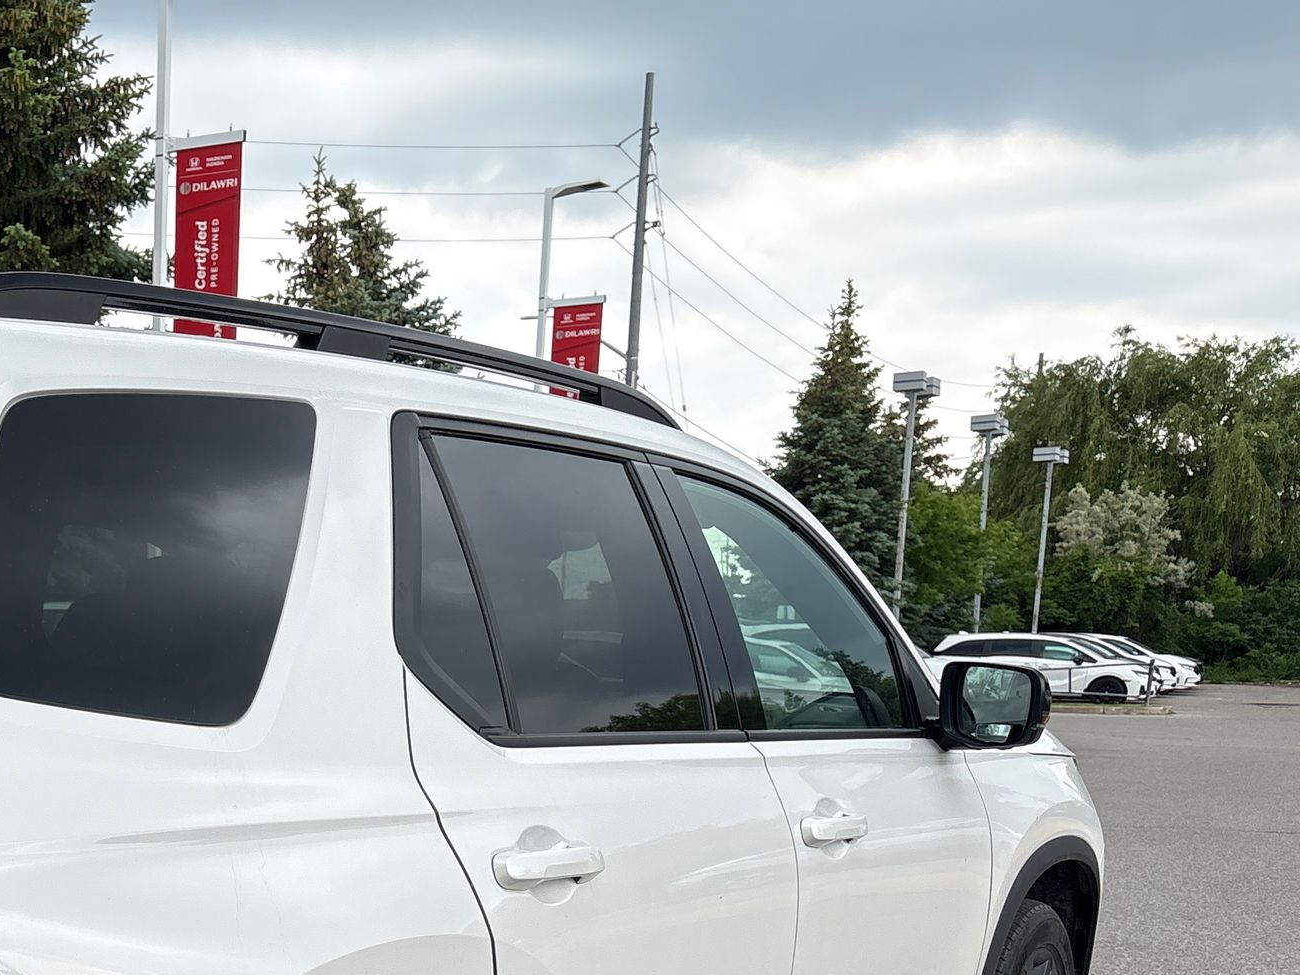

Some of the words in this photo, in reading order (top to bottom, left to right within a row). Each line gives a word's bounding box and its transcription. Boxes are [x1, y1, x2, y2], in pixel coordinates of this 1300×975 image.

[192, 177, 238, 192] DILAWRI
[194, 220, 210, 290] Certified
[209, 218, 220, 288] PRE-OWNED
[565, 328, 600, 338] DILAWRI
